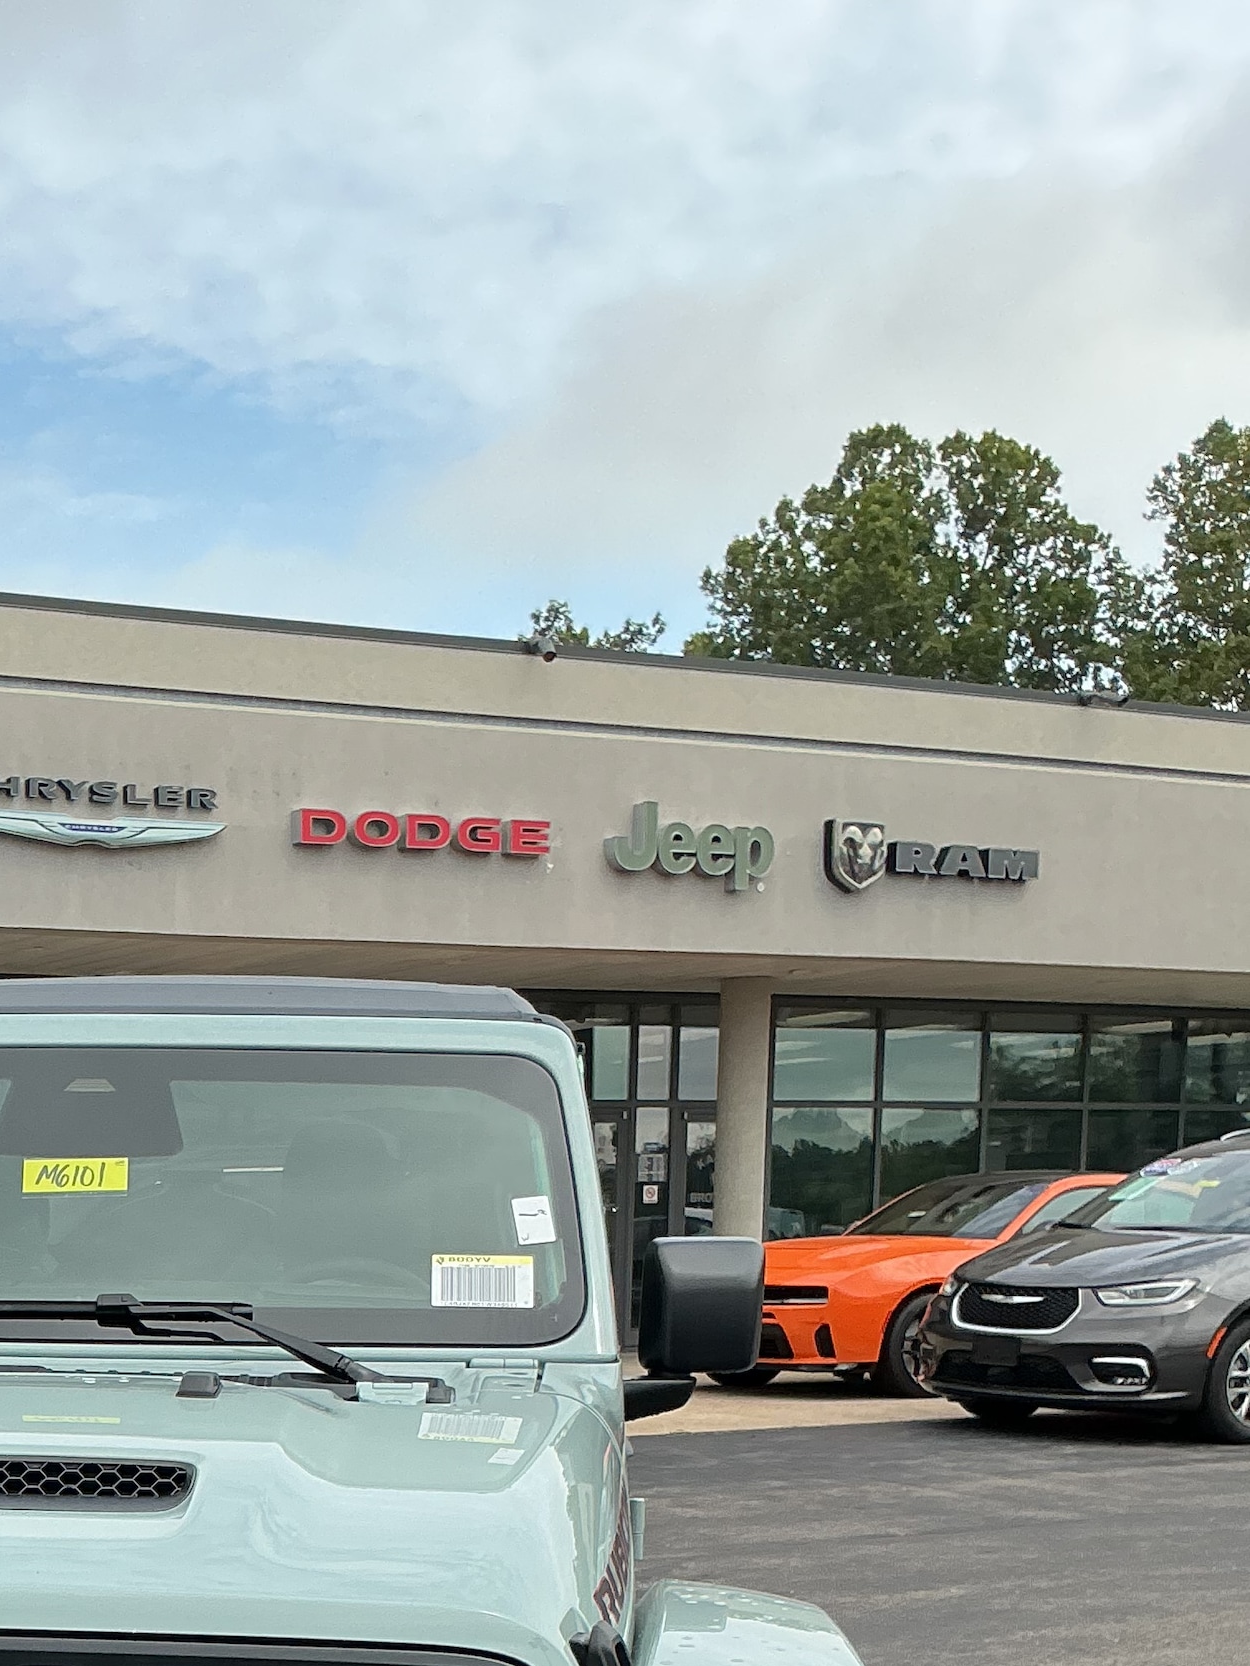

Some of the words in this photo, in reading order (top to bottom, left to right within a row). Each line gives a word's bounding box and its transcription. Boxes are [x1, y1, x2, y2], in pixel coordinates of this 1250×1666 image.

[291, 808, 550, 855] DODGE
[603, 800, 775, 893] Jeep
[886, 841, 1041, 882] RAM
[34, 1161, 107, 1188] M6101
